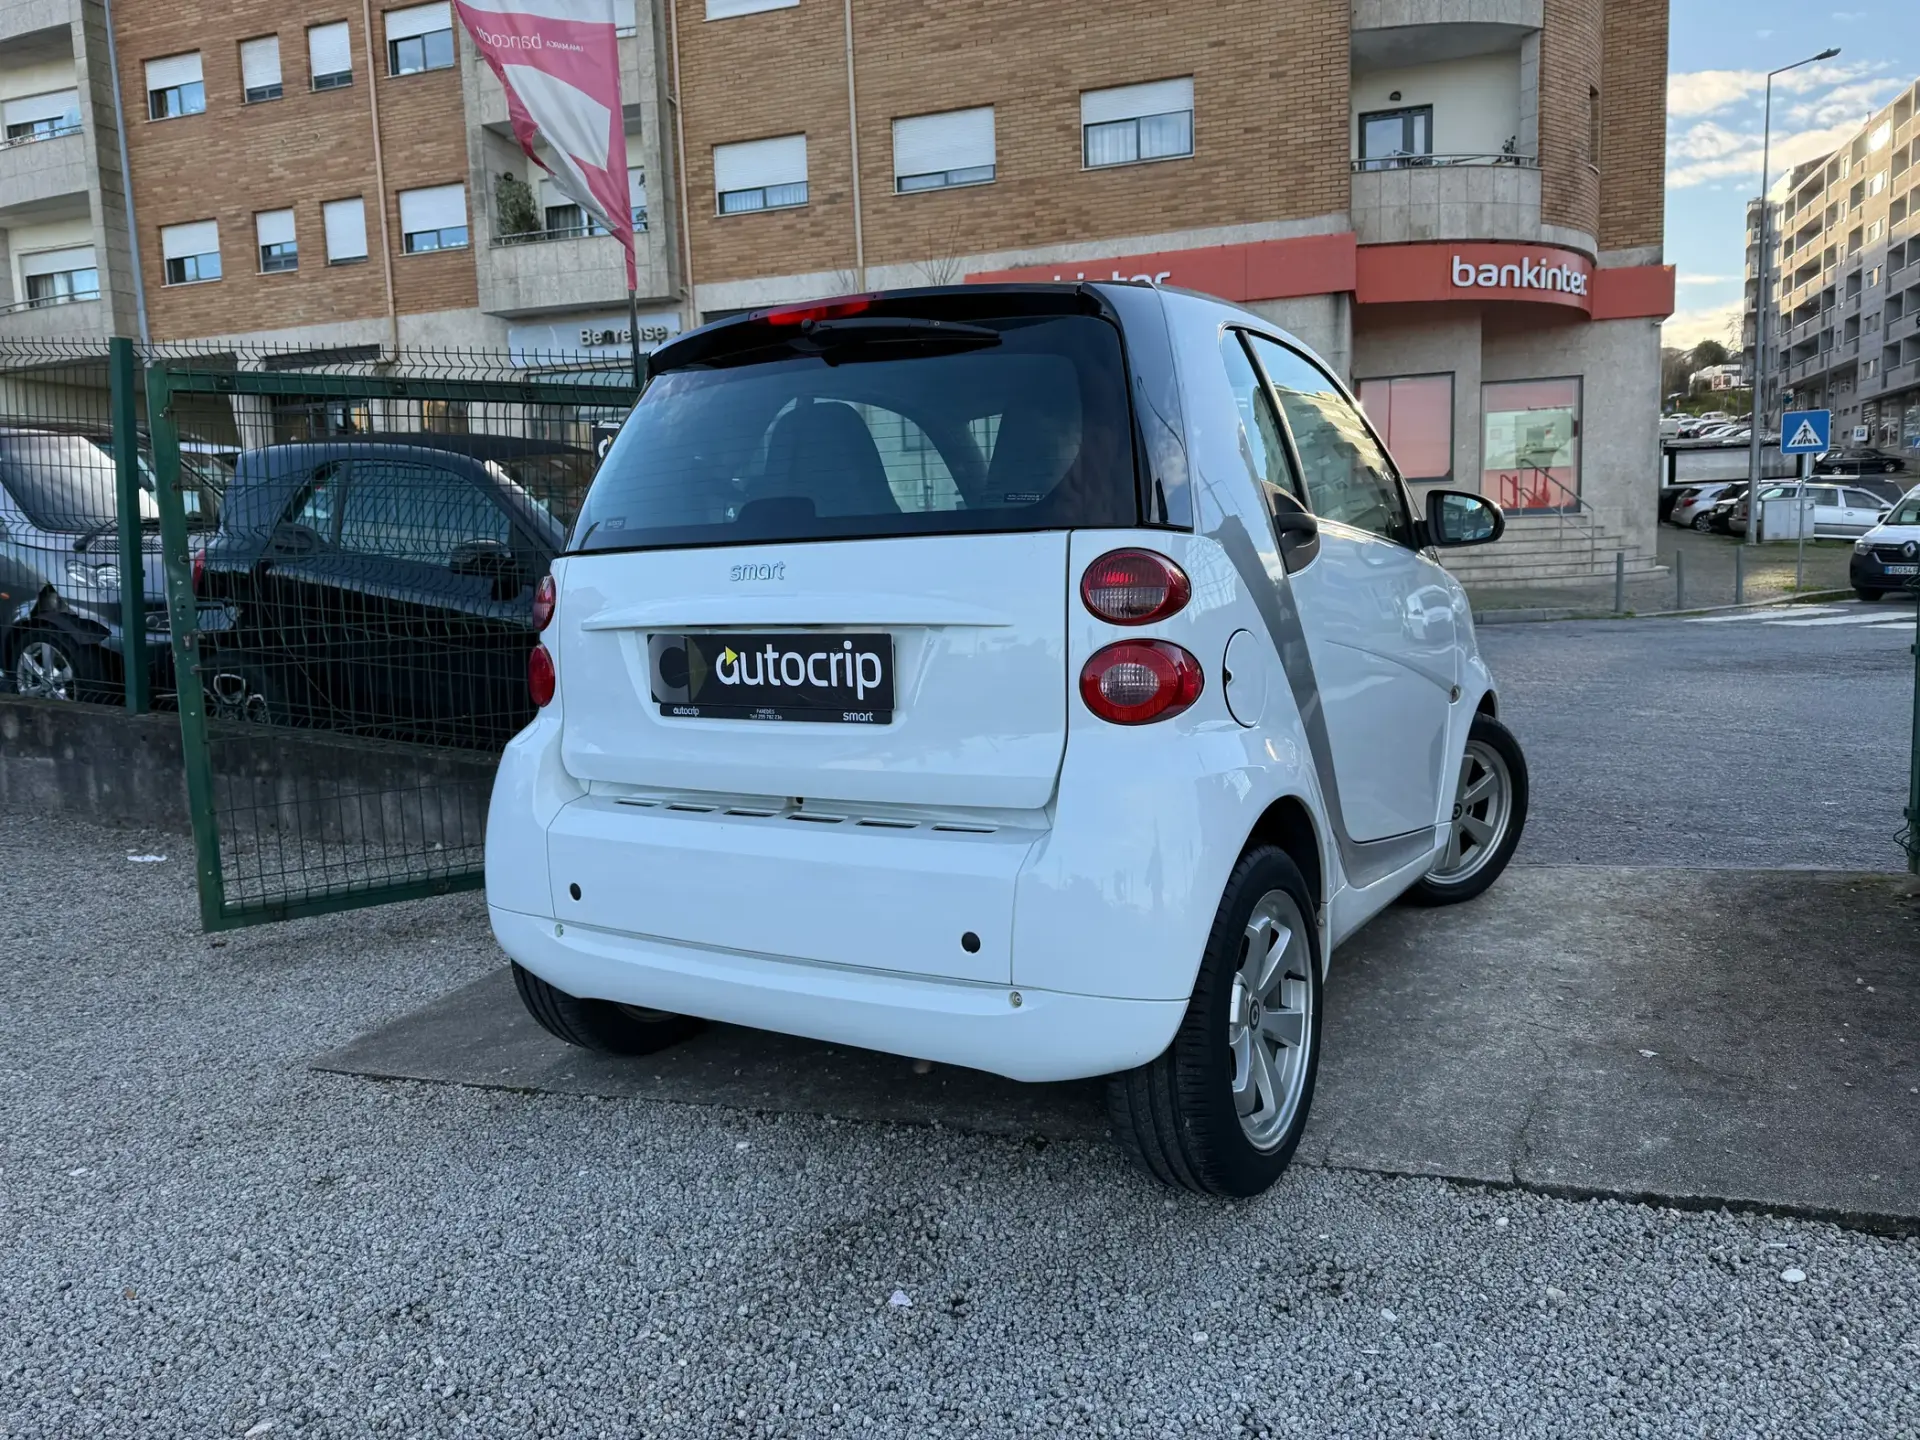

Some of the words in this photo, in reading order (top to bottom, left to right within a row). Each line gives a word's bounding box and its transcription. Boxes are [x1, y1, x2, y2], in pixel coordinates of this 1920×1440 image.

[730, 561, 786, 581] smart
[716, 640, 882, 700] autocrip
[673, 706, 699, 717] autocrip
[842, 711, 873, 721] smart
